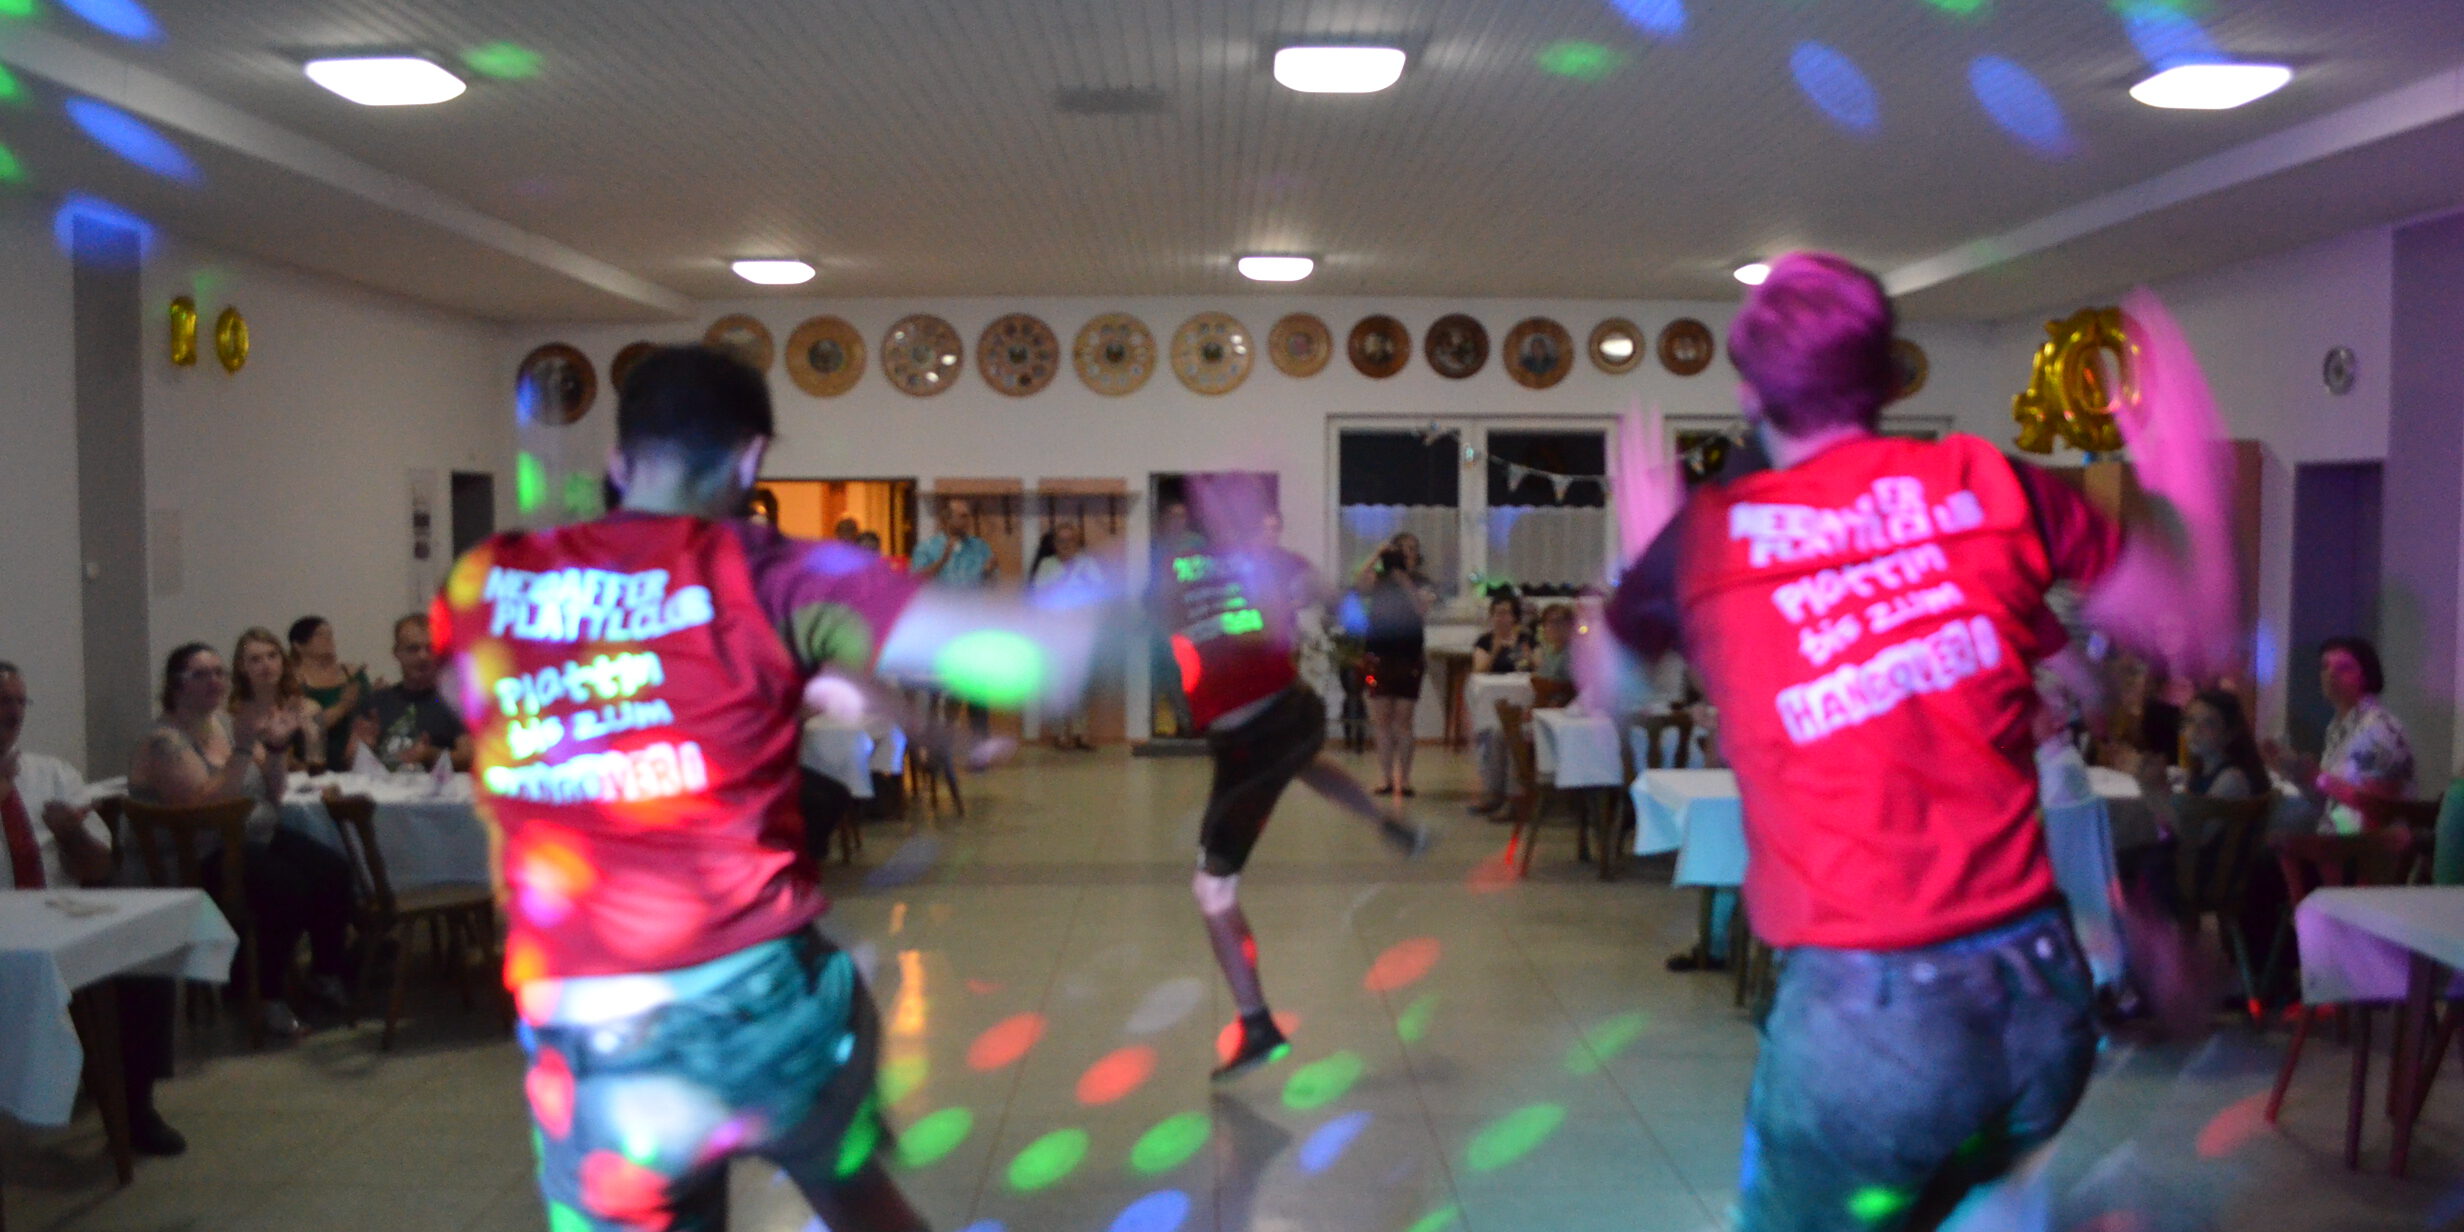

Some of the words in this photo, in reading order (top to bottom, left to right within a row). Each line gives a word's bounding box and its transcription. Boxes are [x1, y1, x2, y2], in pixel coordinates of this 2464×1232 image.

[170, 296, 249, 374] 10
[2011, 308, 2143, 453] 40
[1865, 582, 1965, 634] zum
[572, 699, 674, 741] zum
